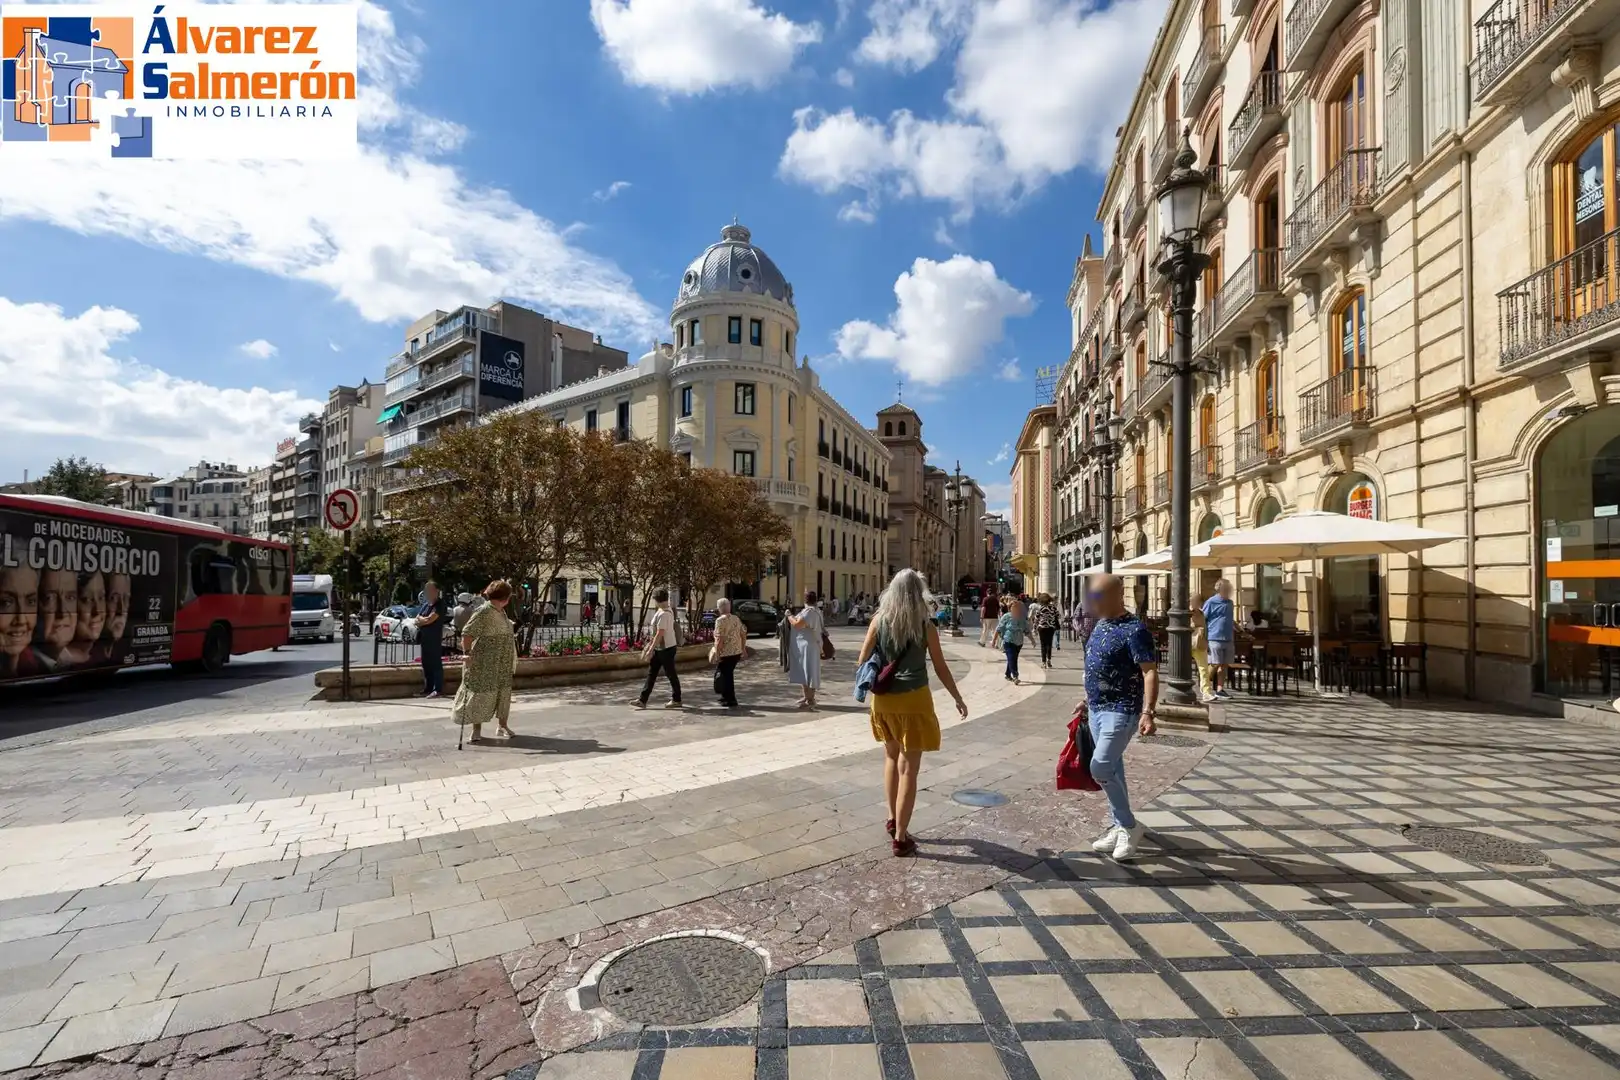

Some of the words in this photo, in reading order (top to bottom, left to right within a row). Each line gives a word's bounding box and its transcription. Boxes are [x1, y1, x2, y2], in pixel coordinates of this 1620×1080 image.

[1577, 189, 1603, 211] DENTAL
[1576, 199, 1604, 221] MESONES
[481, 362, 511, 378] MARCA
[512, 371, 523, 381] LA
[481, 372, 522, 387] DIFERENCIA
[1349, 500, 1373, 511] BURGER
[34, 522, 47, 535] DE
[50, 520, 124, 544] MOCEDADES
[125, 535, 131, 546] A
[0, 532, 18, 567] L
[28, 536, 160, 577] CONSORCIO
[249, 546, 269, 560] alsa
[149, 598, 161, 610] 22
[137, 626, 168, 636] GRANADA
